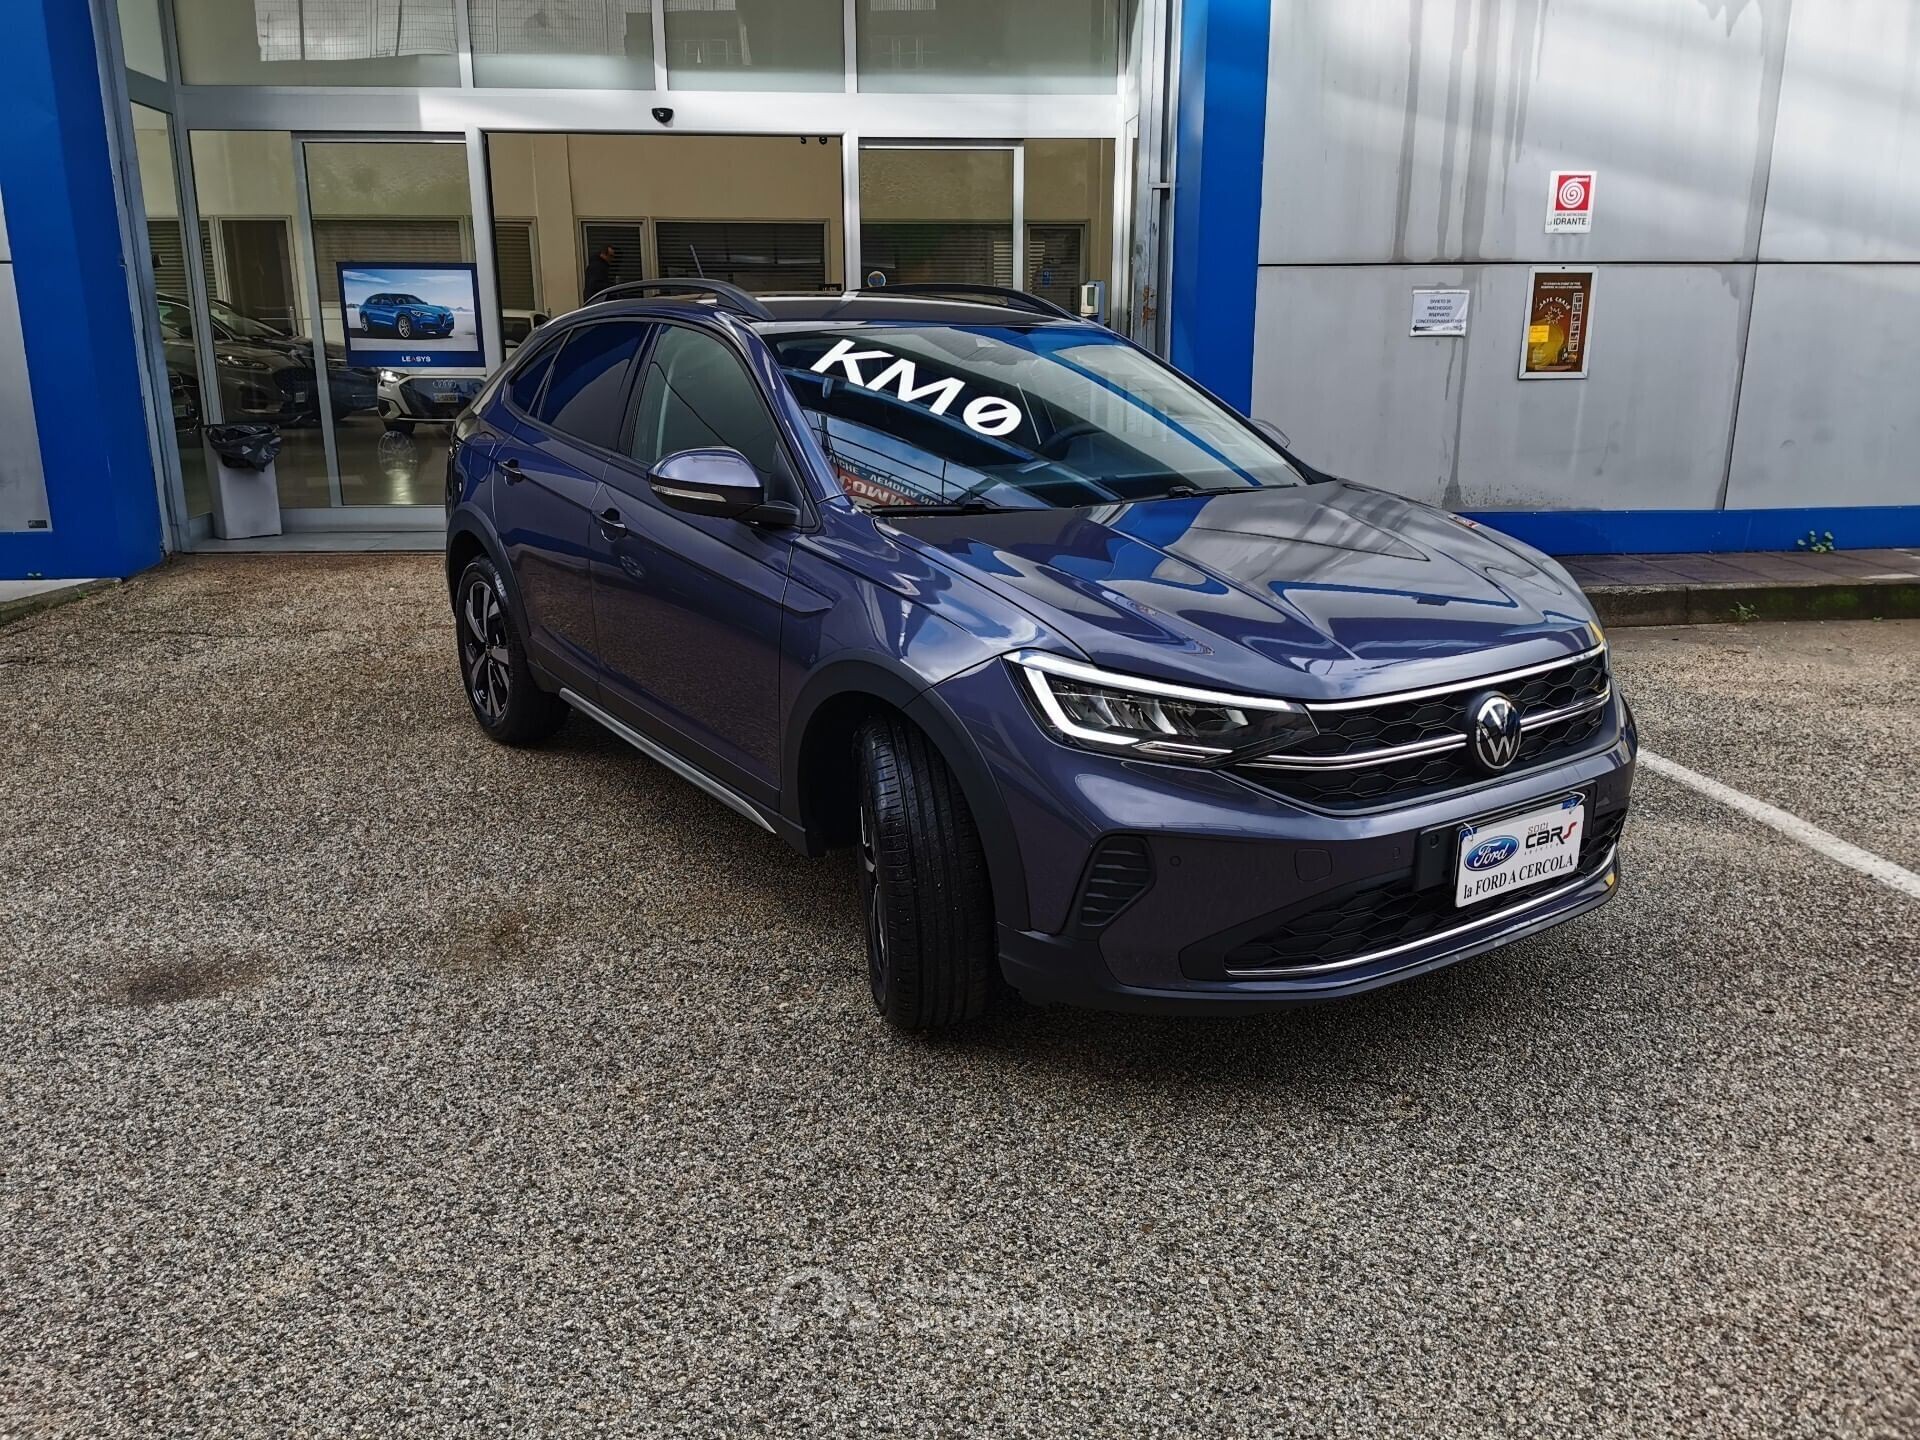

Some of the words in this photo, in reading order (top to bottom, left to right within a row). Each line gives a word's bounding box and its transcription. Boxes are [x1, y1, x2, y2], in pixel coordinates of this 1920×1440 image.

[1553, 217, 1587, 225] IDRANTE
[1472, 841, 1510, 868] Ford
[1463, 884, 1472, 899] la
[1475, 872, 1507, 895] FORD
[1509, 869, 1517, 885] A
[1519, 853, 1574, 881] CERCOLA
